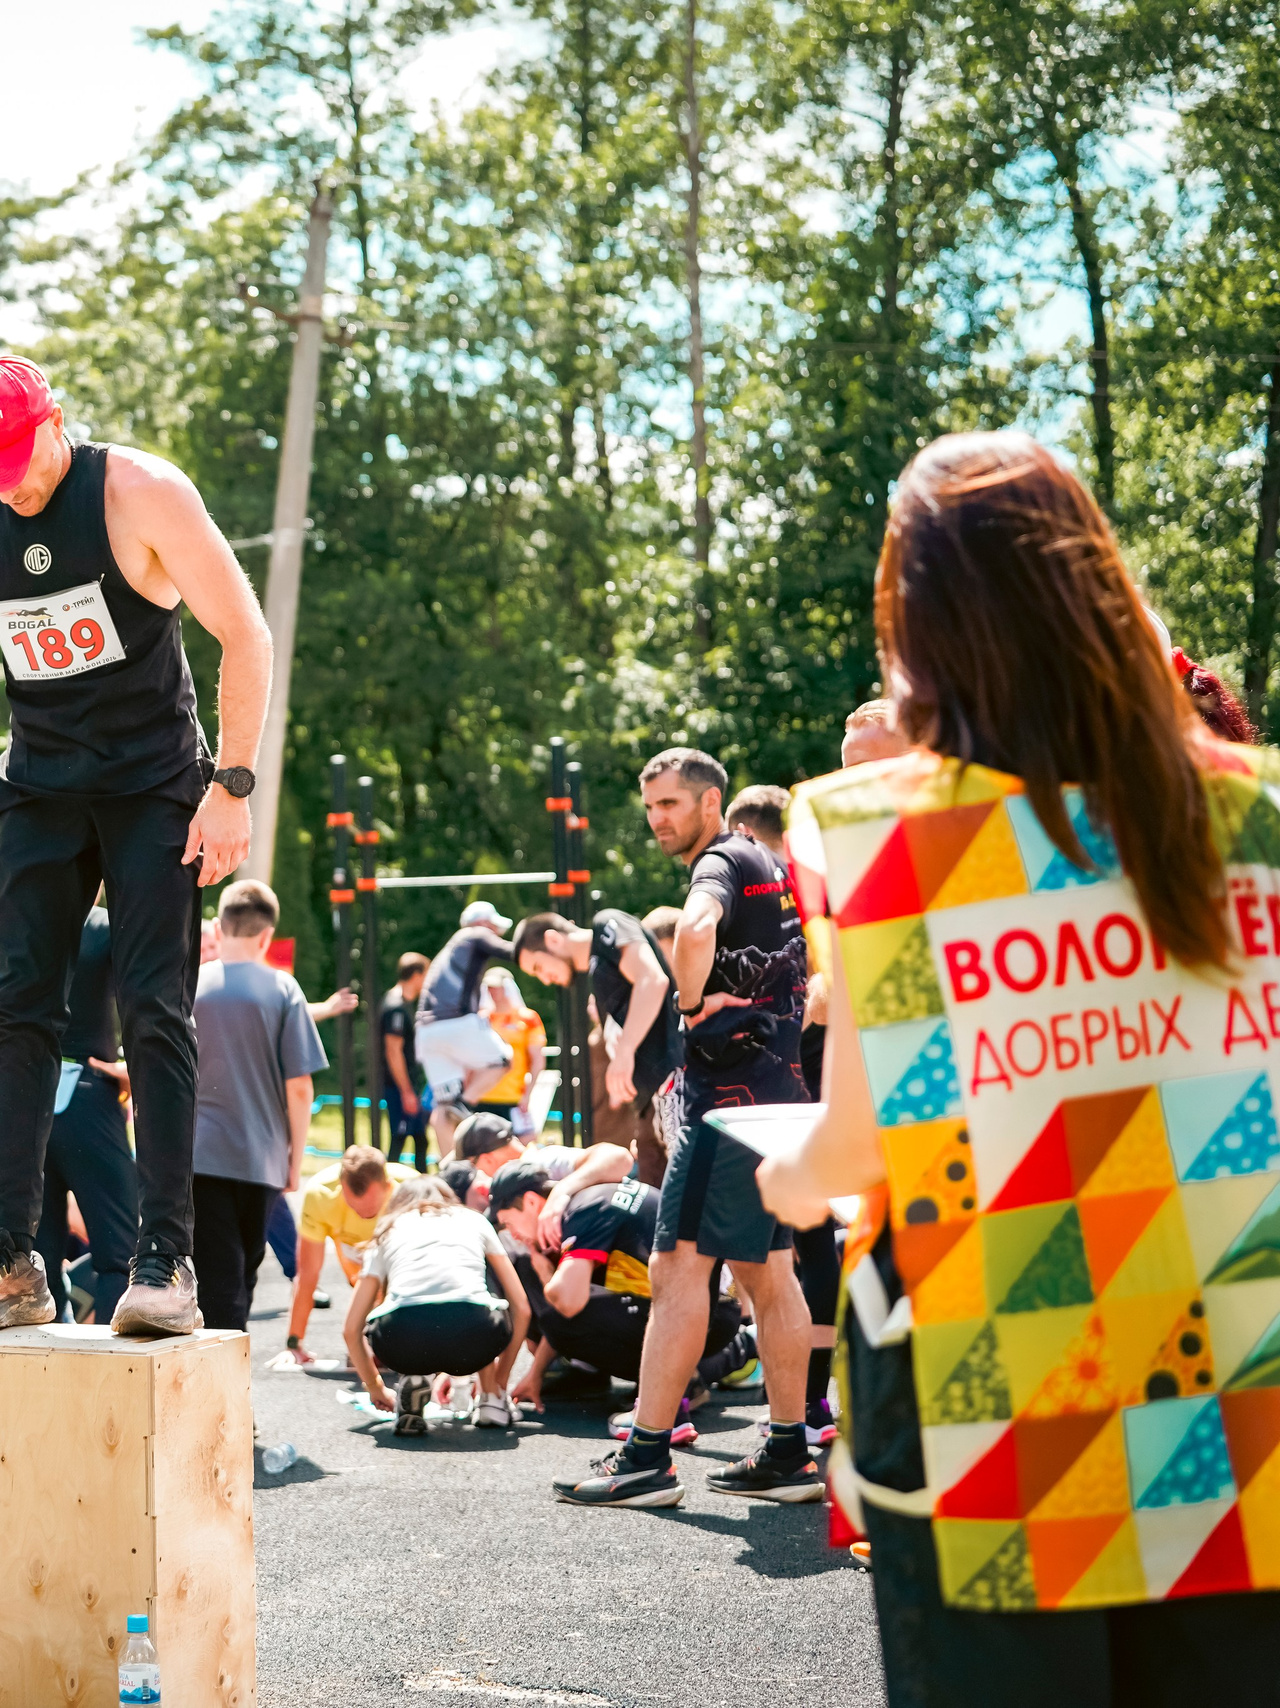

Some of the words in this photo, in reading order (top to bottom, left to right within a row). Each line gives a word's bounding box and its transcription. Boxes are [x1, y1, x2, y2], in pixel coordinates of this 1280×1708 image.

[8, 618, 57, 630] BOGAL
[11, 617, 105, 671] 189
[65, 661, 101, 675] МАРАФОН
[970, 995, 1192, 1096] ДОБРЫХ
